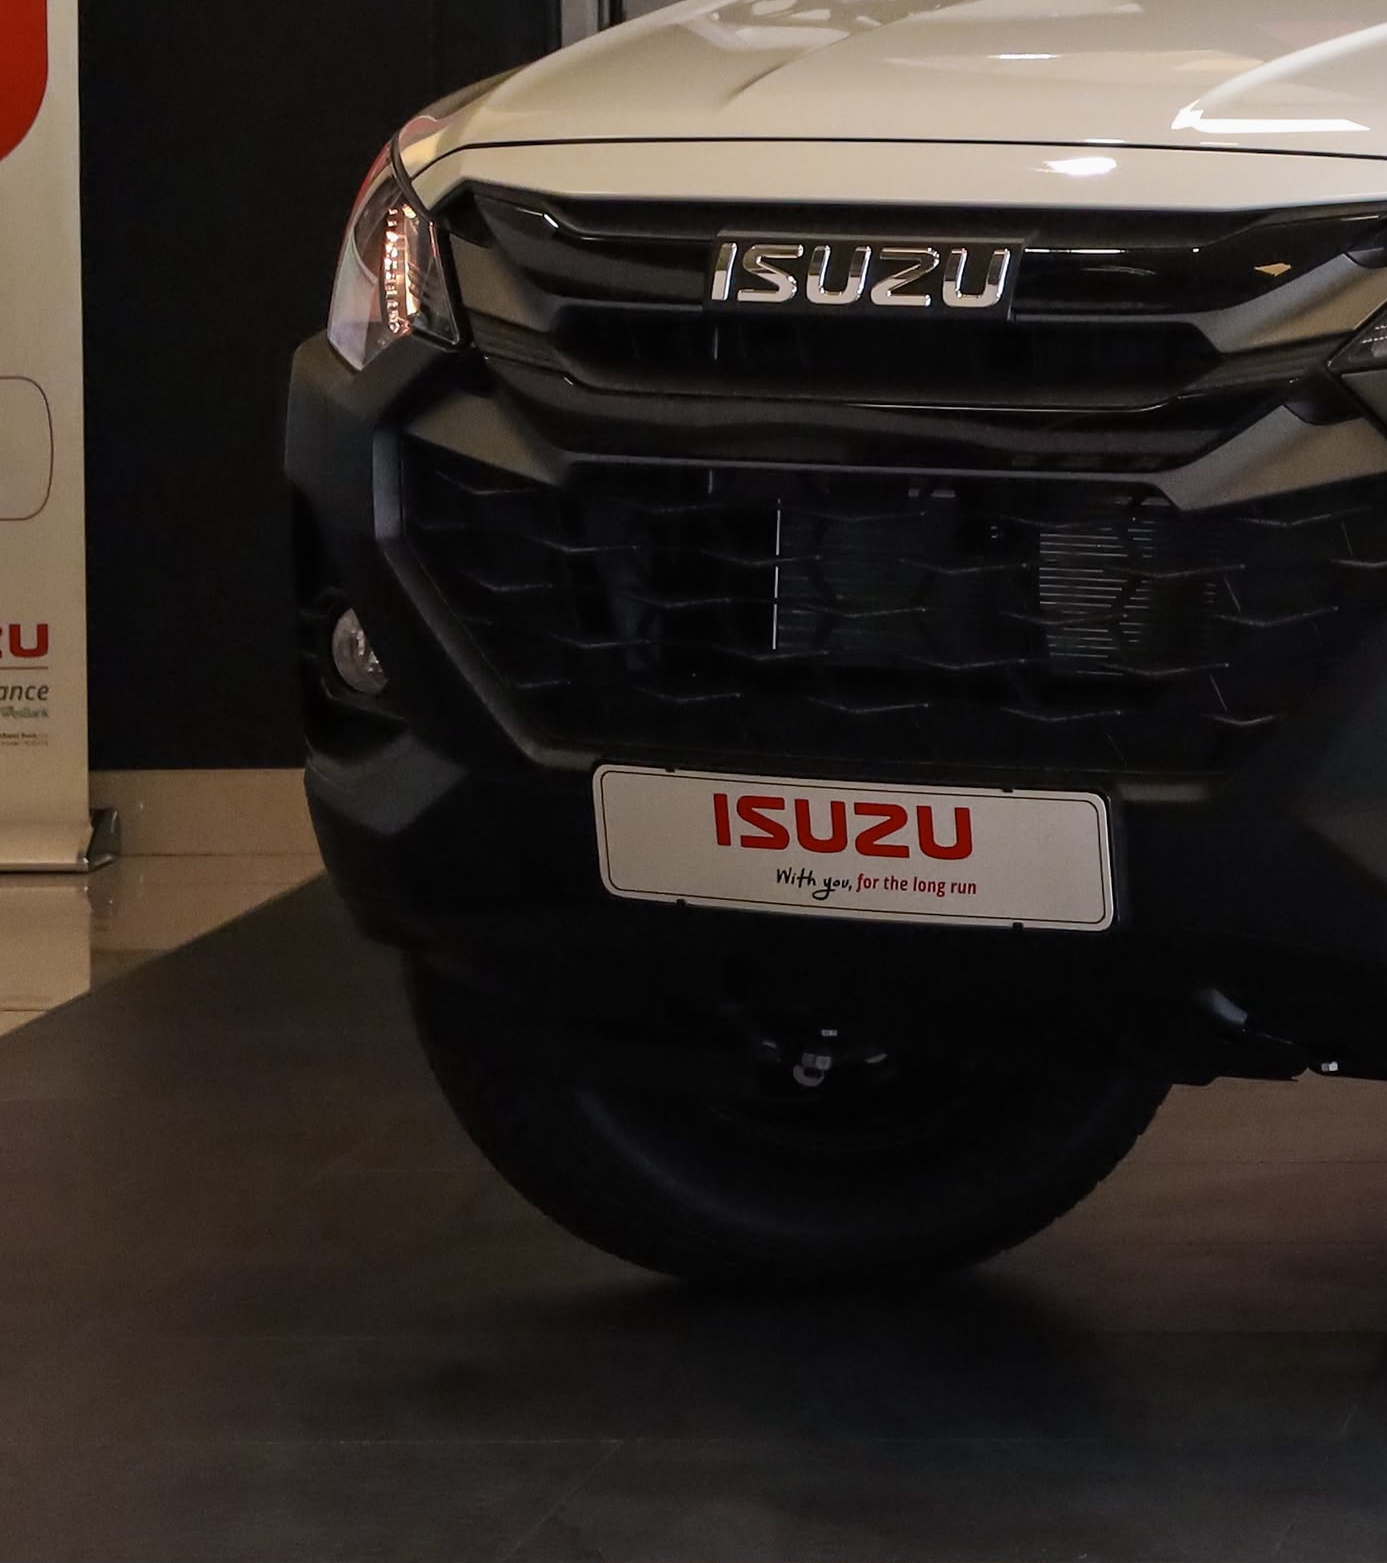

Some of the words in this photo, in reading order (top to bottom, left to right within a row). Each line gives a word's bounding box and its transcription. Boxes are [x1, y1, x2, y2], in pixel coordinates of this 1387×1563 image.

[711, 242, 1011, 308] ISUZU
[712, 793, 974, 860] ISUZU
[776, 867, 816, 888] With
[812, 876, 853, 901] you,
[856, 873, 879, 893] for
[883, 875, 908, 891] the
[913, 876, 946, 897] long
[950, 881, 977, 894] run
